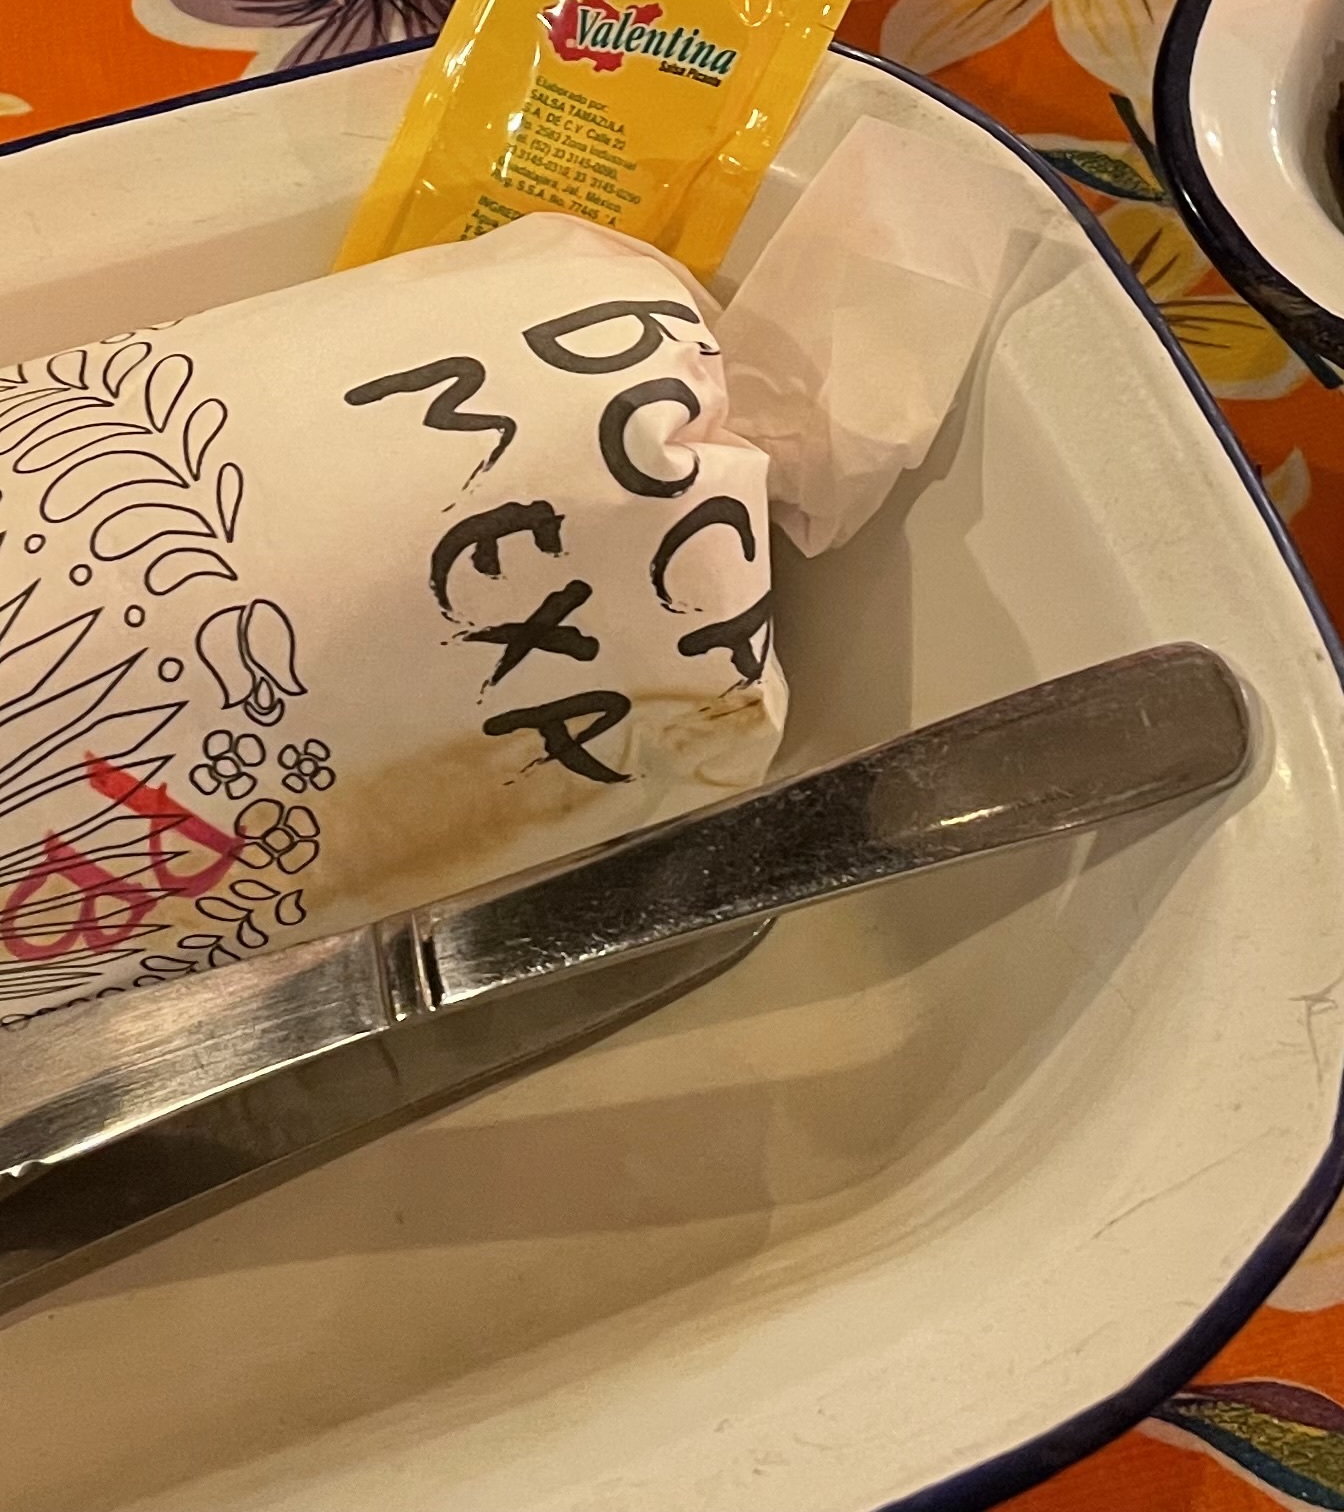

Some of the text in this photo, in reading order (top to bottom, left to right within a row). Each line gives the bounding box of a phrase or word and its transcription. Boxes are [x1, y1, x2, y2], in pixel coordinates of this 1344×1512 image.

[576, 6, 738, 76] Valentina
[530, 88, 625, 134] SALSA TAMAZULA
[546, 112, 563, 127] DE
